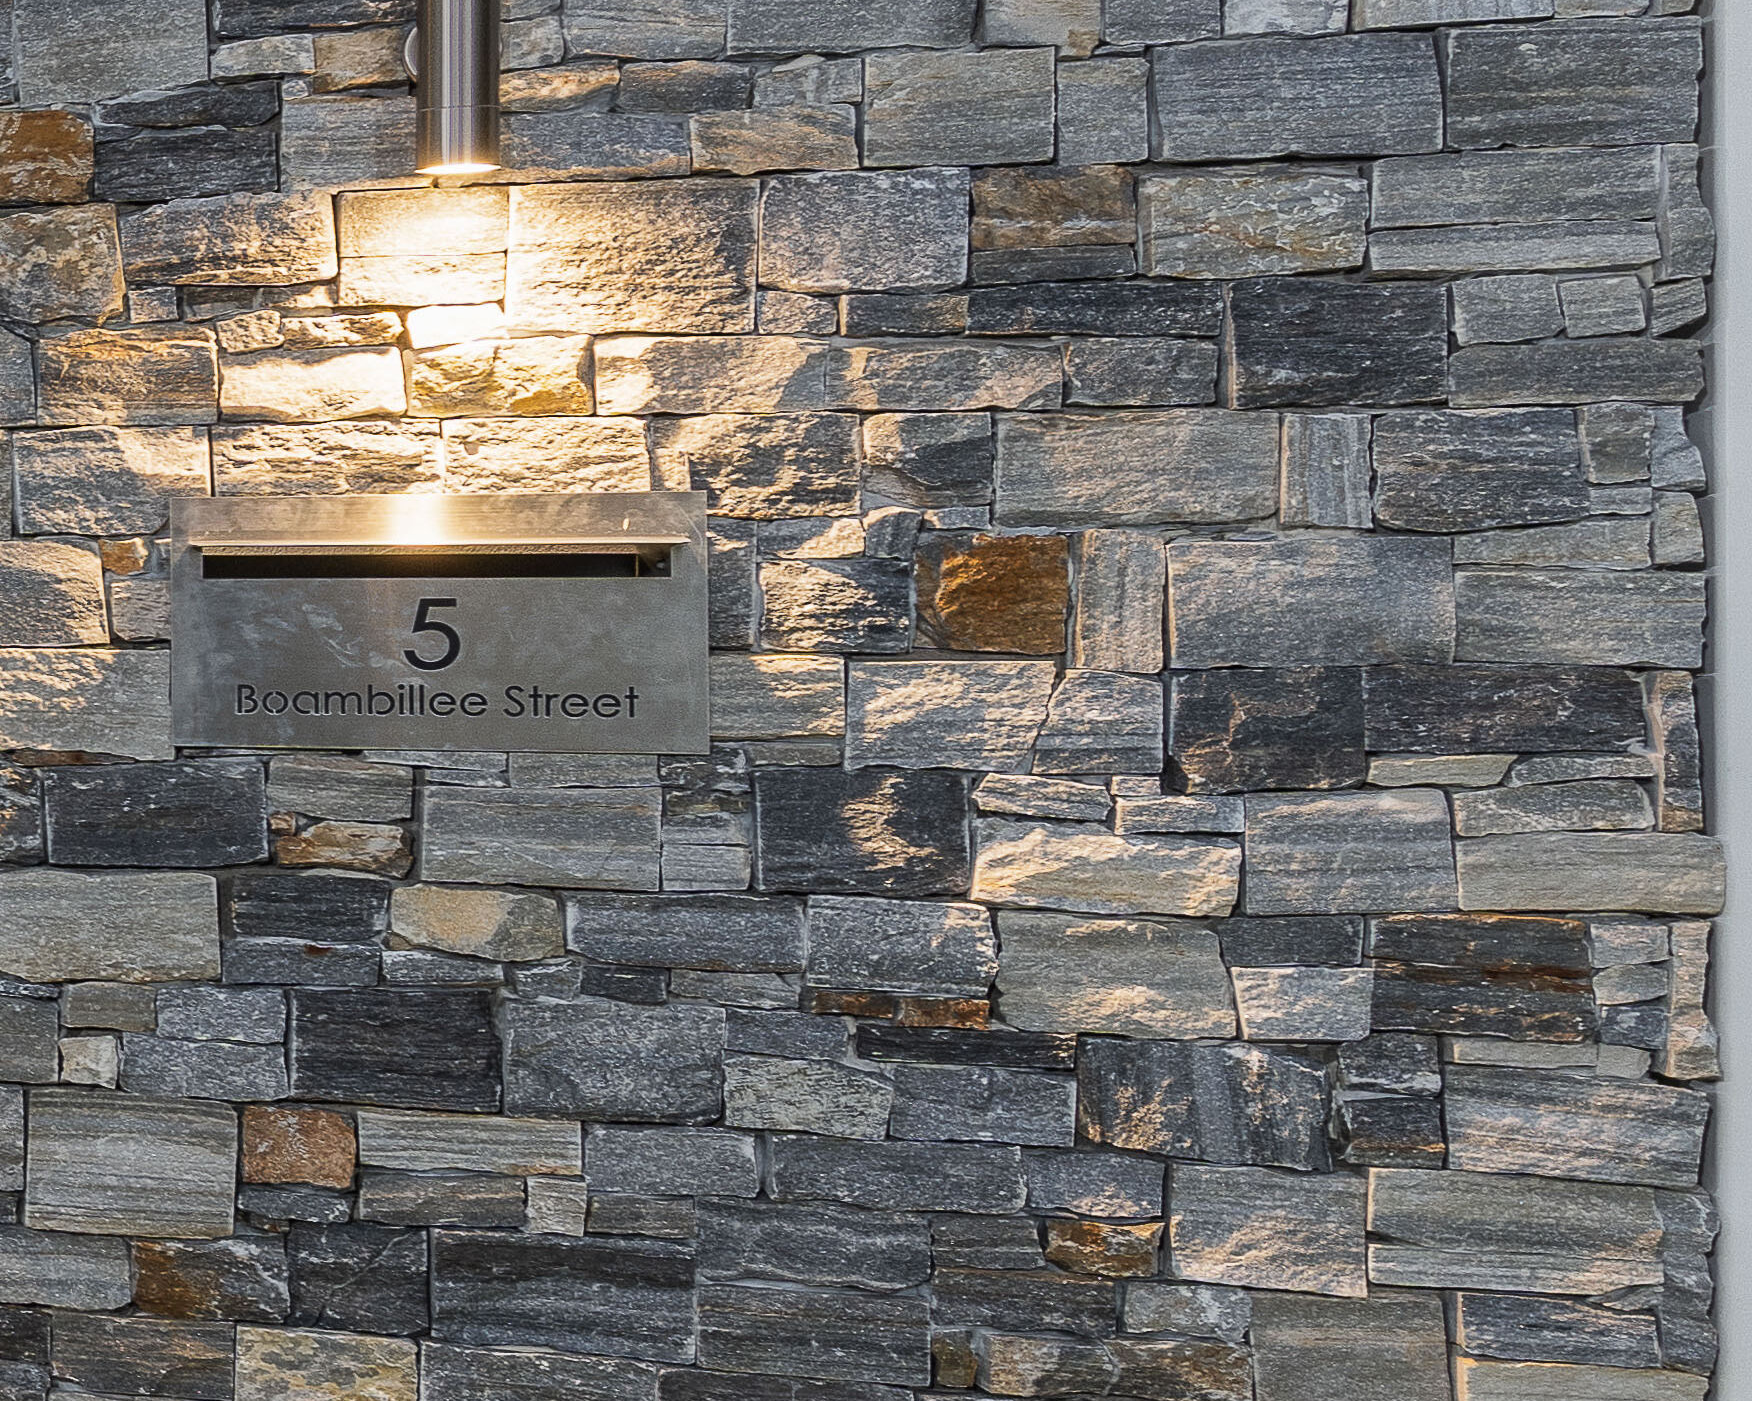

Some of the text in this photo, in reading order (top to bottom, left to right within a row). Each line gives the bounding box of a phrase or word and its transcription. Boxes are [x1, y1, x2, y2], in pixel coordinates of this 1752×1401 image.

[403, 598, 461, 671] 5
[235, 684, 639, 718] Boambillee Street
